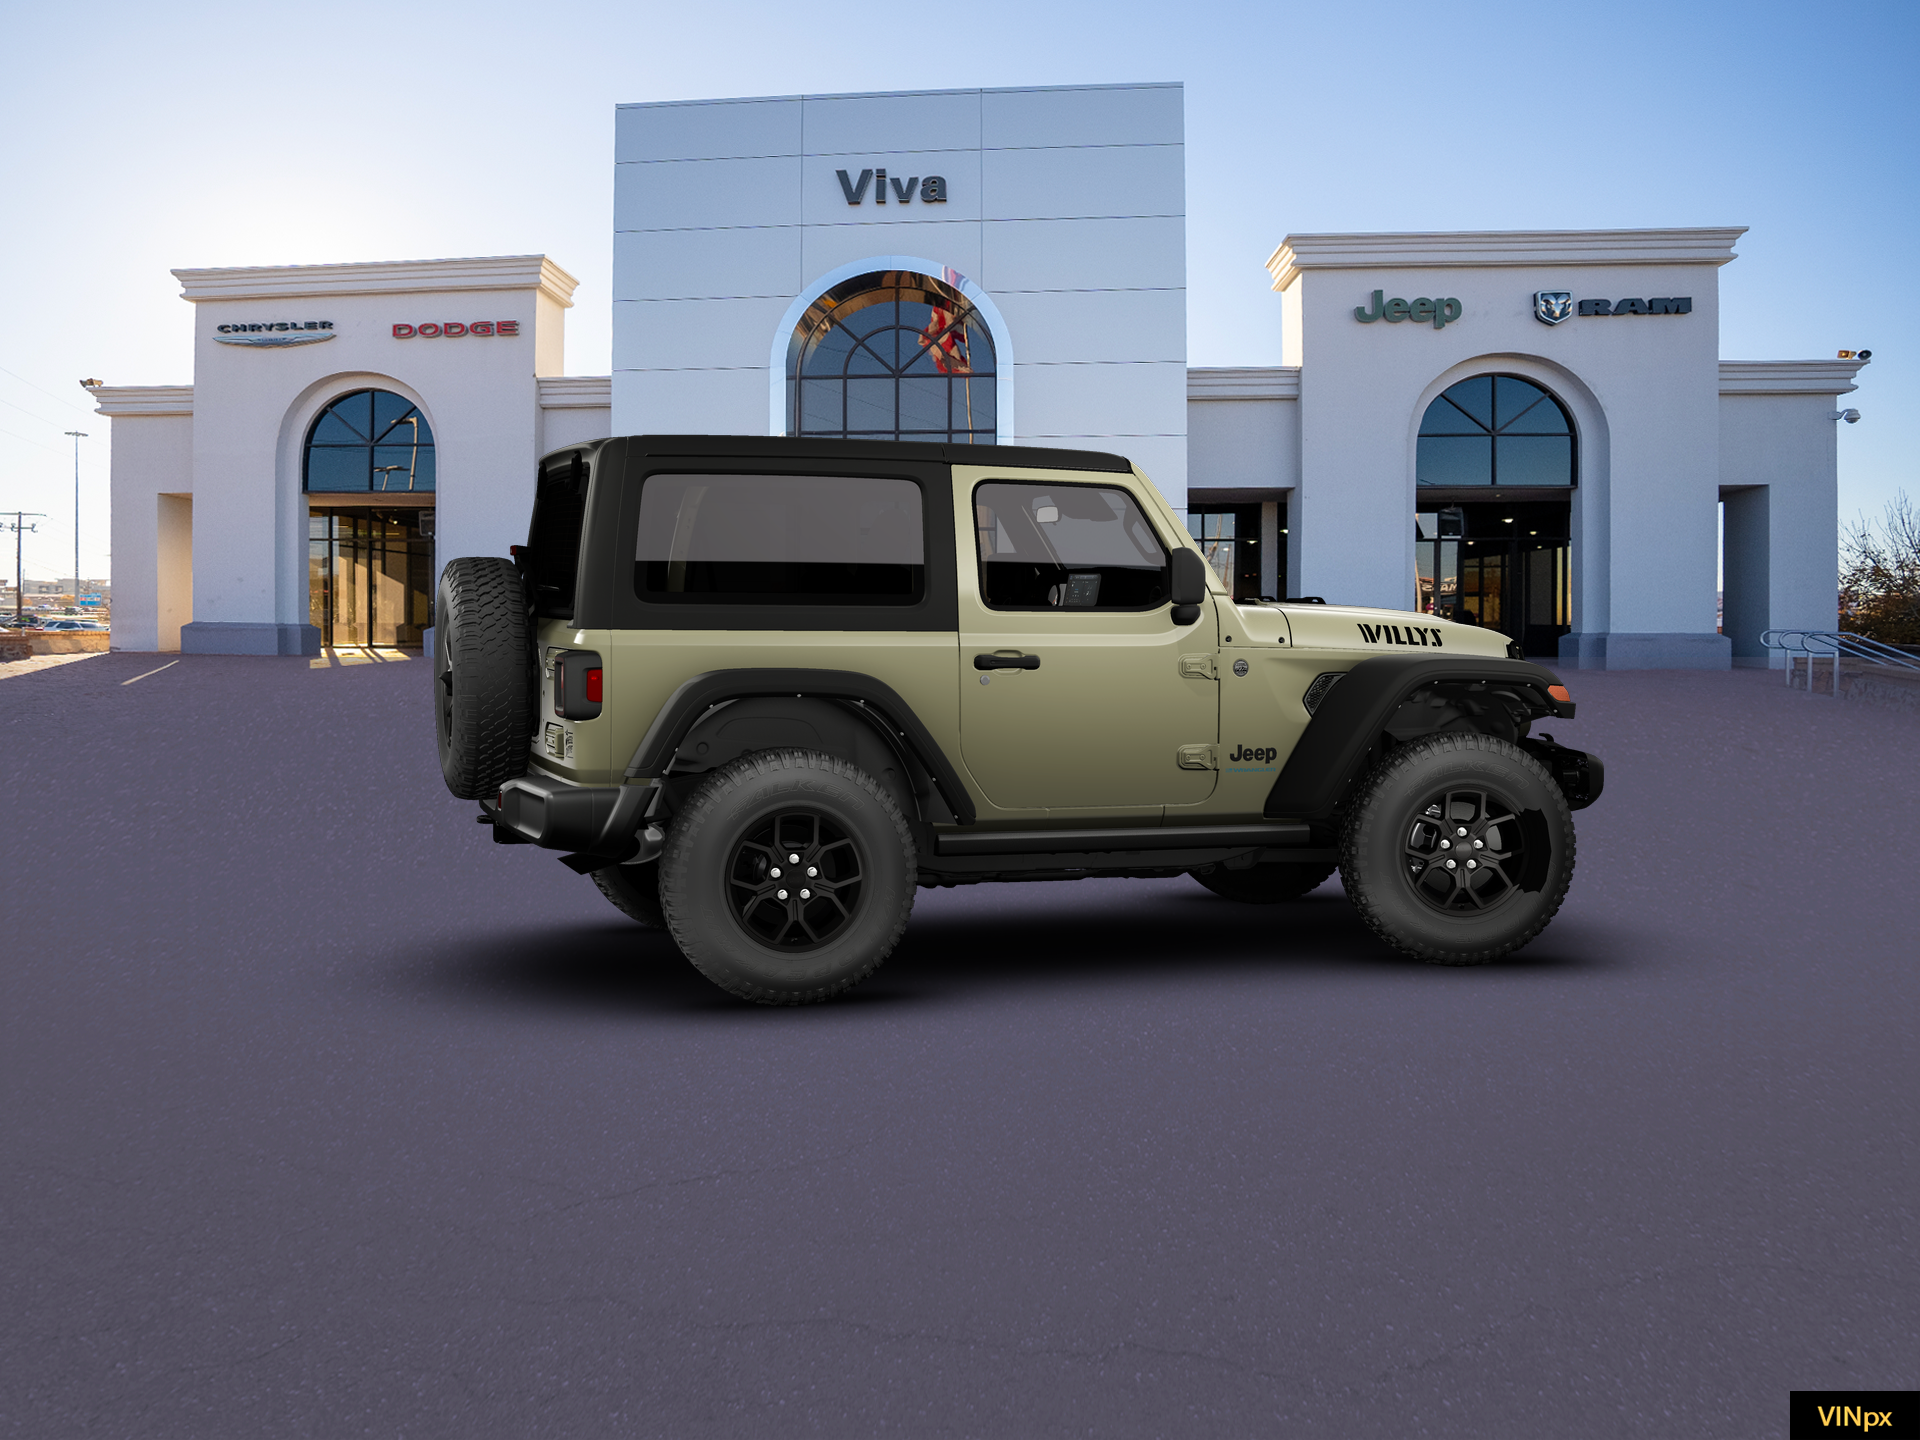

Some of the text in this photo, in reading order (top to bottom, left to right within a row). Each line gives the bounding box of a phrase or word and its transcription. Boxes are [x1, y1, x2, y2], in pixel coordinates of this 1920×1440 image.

[835, 168, 947, 205] Viva
[1353, 289, 1462, 329] Jeep
[1578, 297, 1692, 316] RAM
[217, 320, 334, 334] CHRYSLER
[392, 319, 520, 340] DODGE
[1357, 623, 1443, 647] WILLYS
[1229, 744, 1277, 764] Jeep
[1405, 759, 1530, 796] FALKEN
[726, 778, 867, 821] FALKEN
